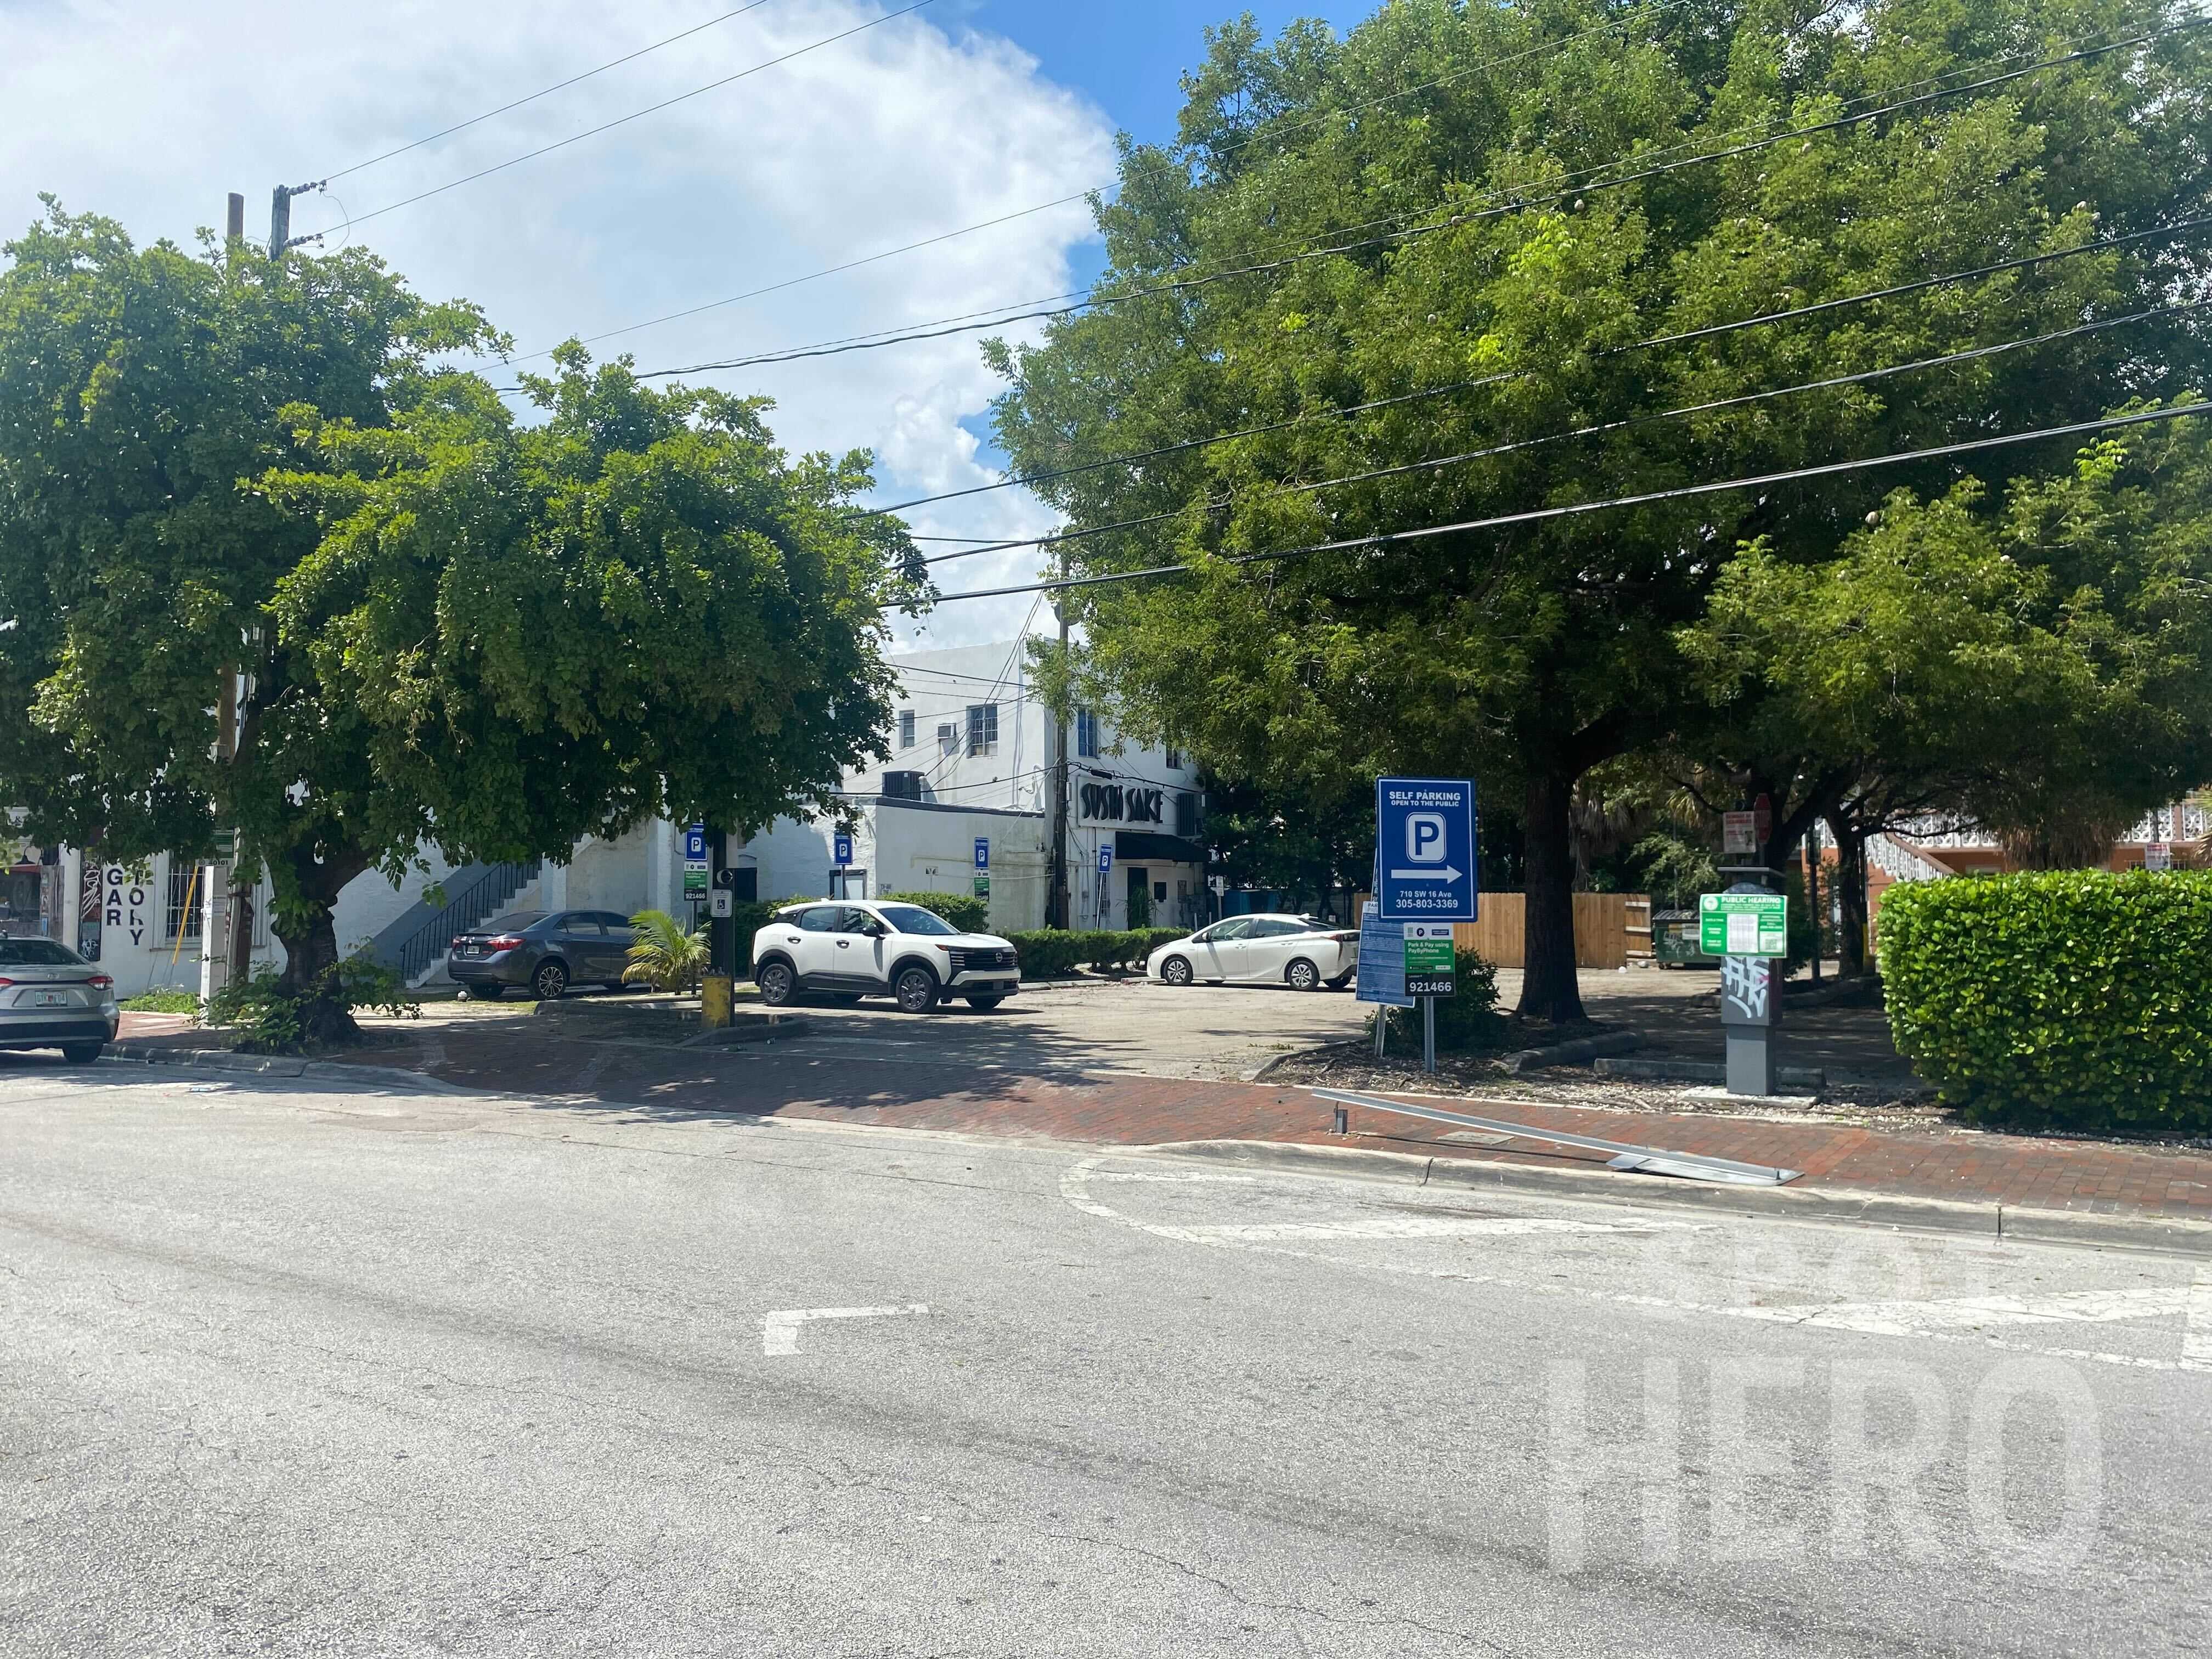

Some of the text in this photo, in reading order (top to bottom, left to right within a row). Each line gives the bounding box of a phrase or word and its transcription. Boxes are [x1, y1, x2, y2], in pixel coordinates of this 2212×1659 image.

[1389, 792, 1460, 800] SELF PARKING
[1126, 788, 1163, 823] SAKE
[1415, 821, 1439, 856] P
[1396, 899, 1458, 908] 305-803-3369
[1409, 982, 1452, 992] 921466
